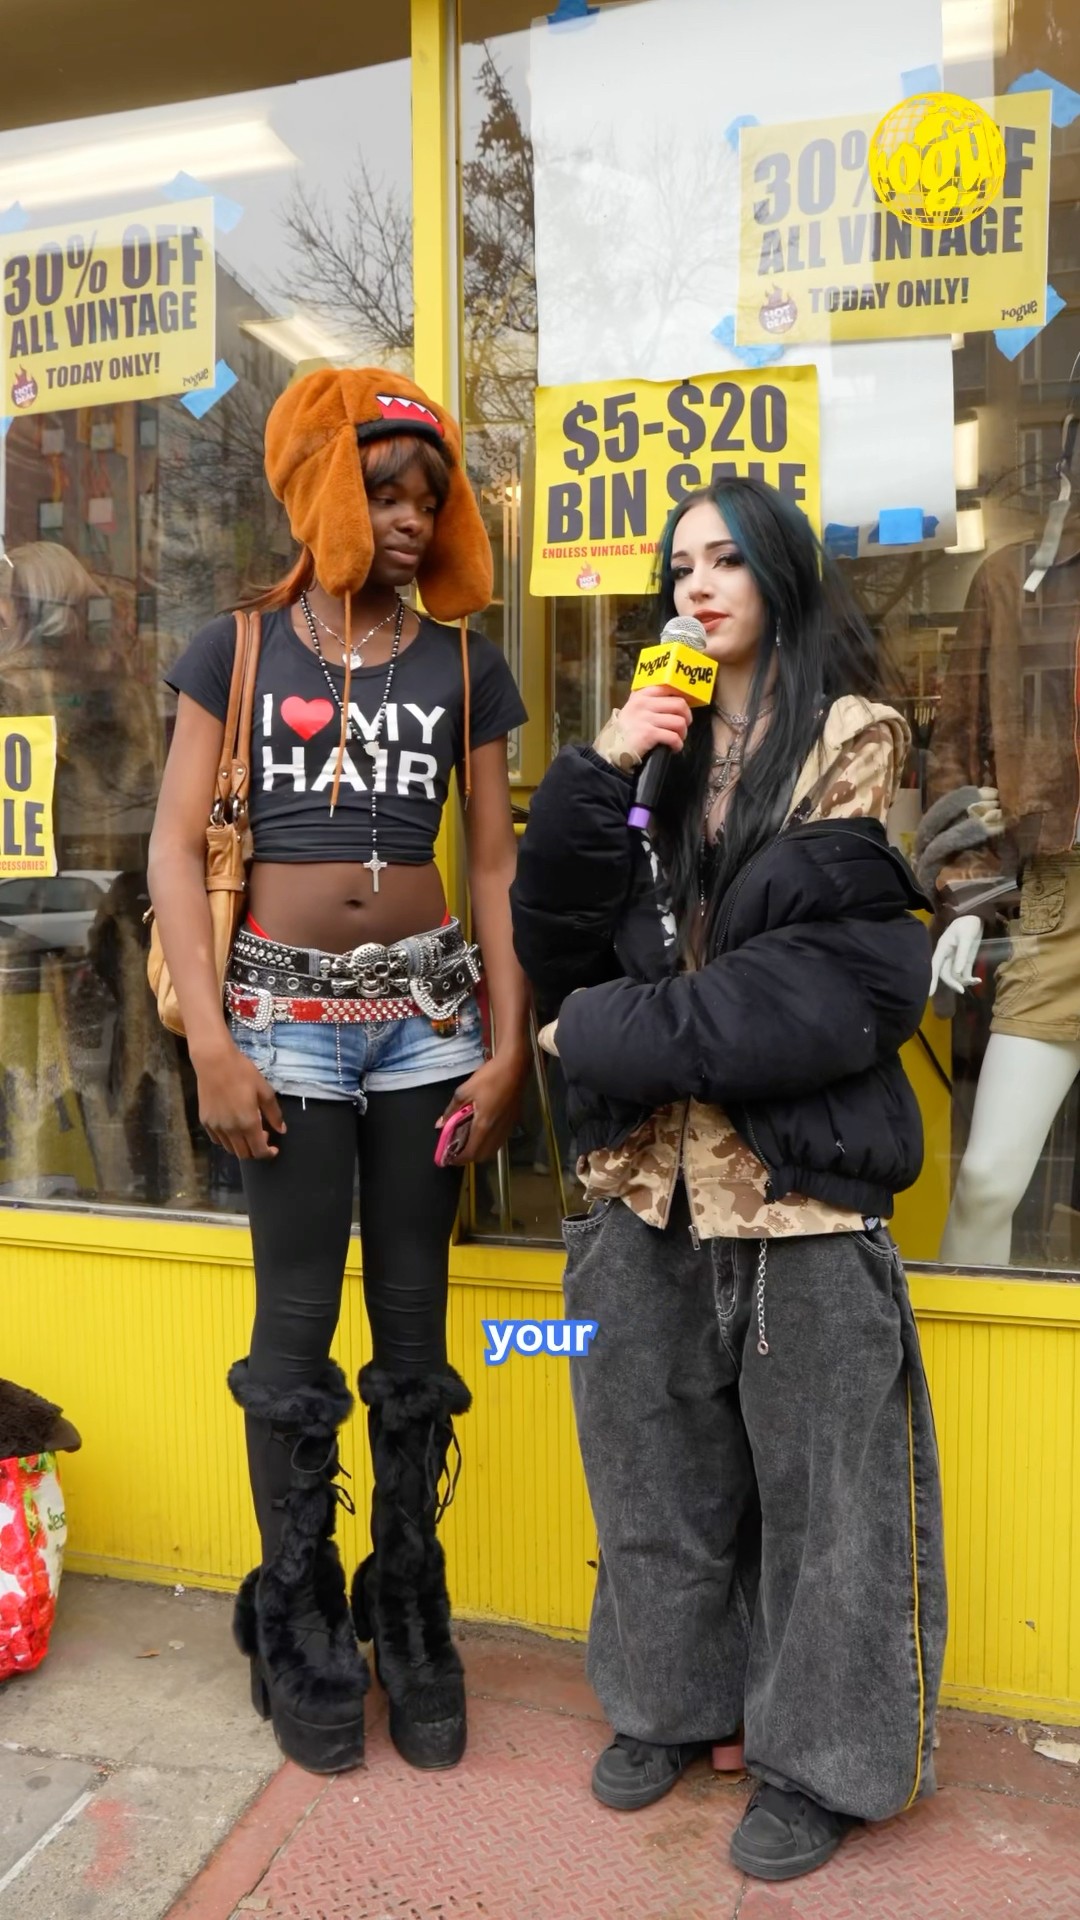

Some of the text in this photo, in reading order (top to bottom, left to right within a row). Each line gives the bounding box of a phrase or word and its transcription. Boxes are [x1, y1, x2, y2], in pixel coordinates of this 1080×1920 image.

[758, 206, 1023, 276] ALL VINTAGE
[4, 223, 204, 317] 30% OFF
[808, 277, 970, 314] TODAY ONLY!
[9, 291, 197, 359] ALL VINTAGE
[1001, 299, 1038, 322] rogue
[46, 352, 161, 390] TODAY ONLY!
[562, 379, 788, 476] $5-$20
[546, 468, 647, 545] BIN
[542, 546, 588, 559] ENDLESS
[590, 544, 638, 557] VINTAGE,
[638, 651, 714, 685] rogue rogue
[262, 693, 446, 745] I MY
[262, 746, 438, 800] HAIR
[0, 798, 45, 857] LE
[0, 860, 48, 871] CESSORIES!
